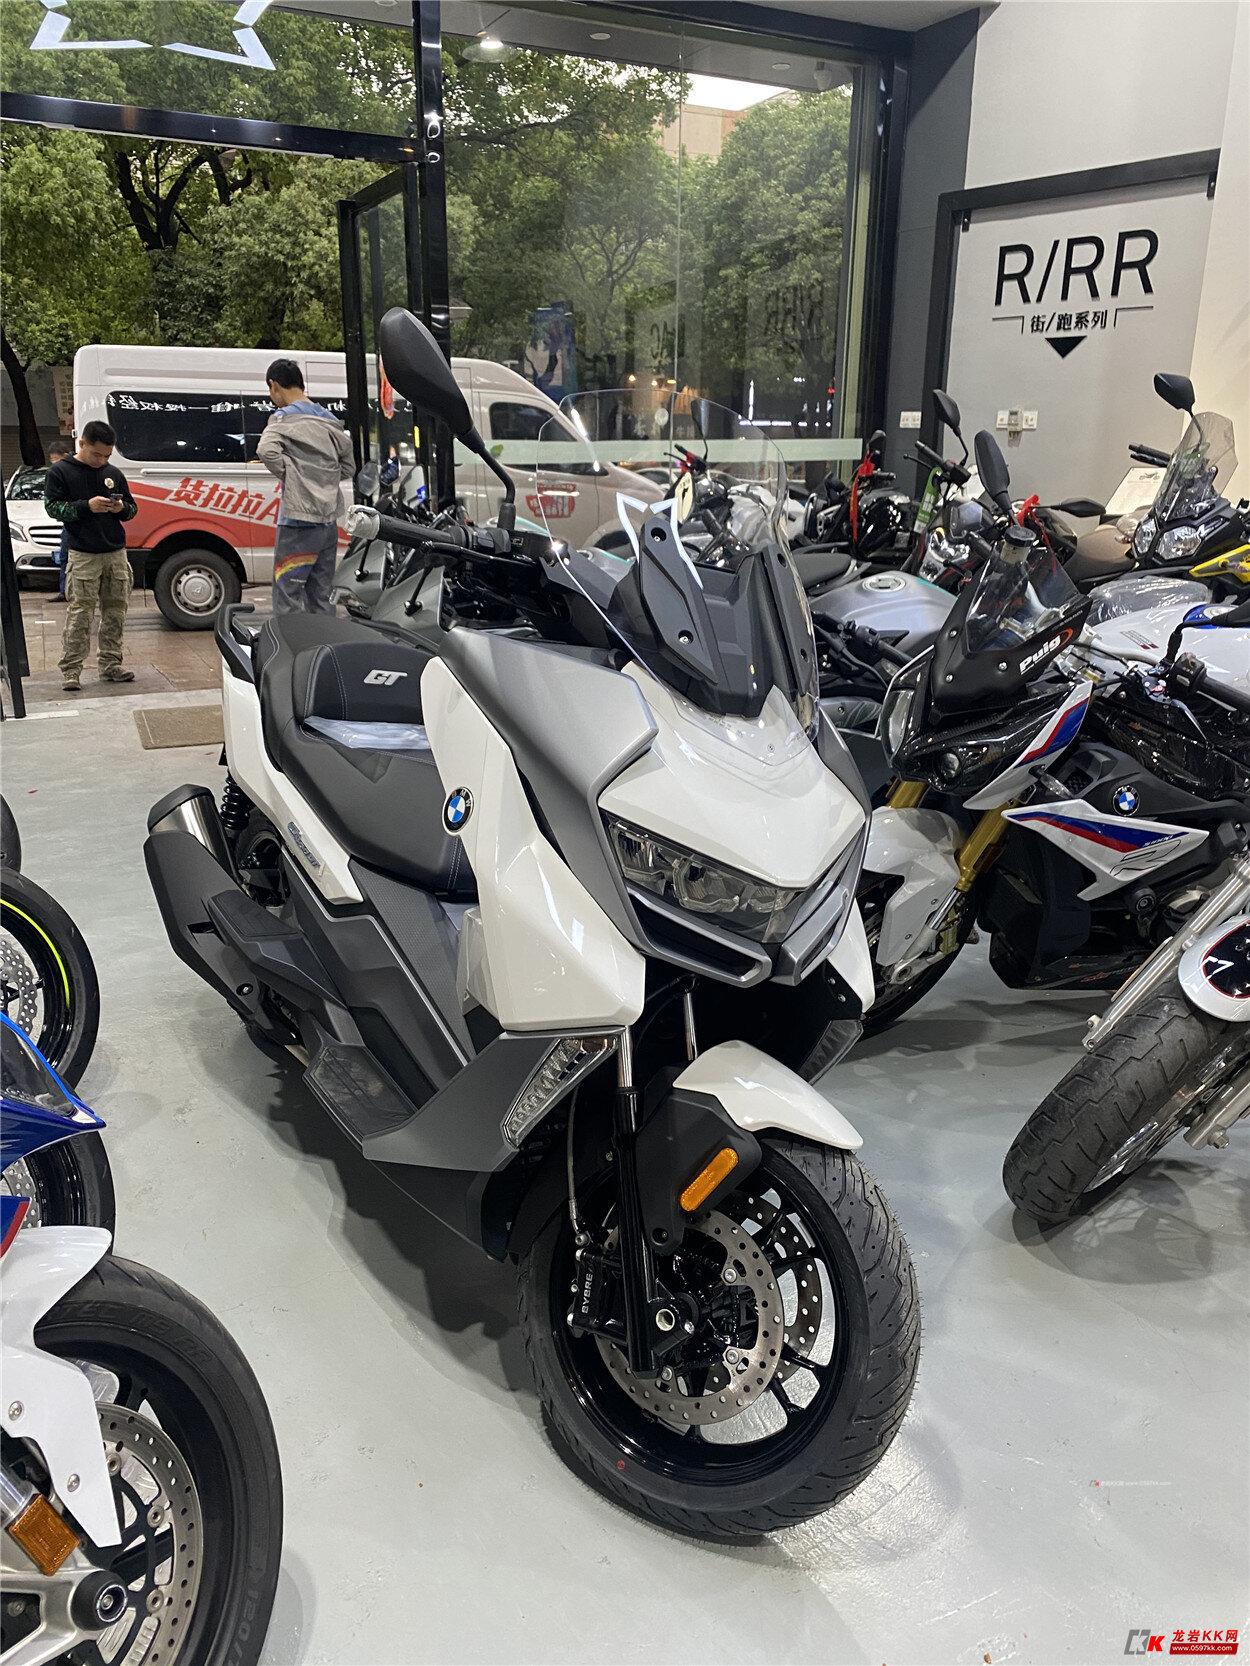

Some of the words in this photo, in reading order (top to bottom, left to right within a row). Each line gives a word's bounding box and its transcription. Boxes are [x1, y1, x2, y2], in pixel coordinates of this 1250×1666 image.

[994, 228, 1159, 306] R/RR
[1030, 309, 1109, 334] 街/跑系列
[1019, 635, 1061, 672] Puig
[363, 669, 408, 686] GT
